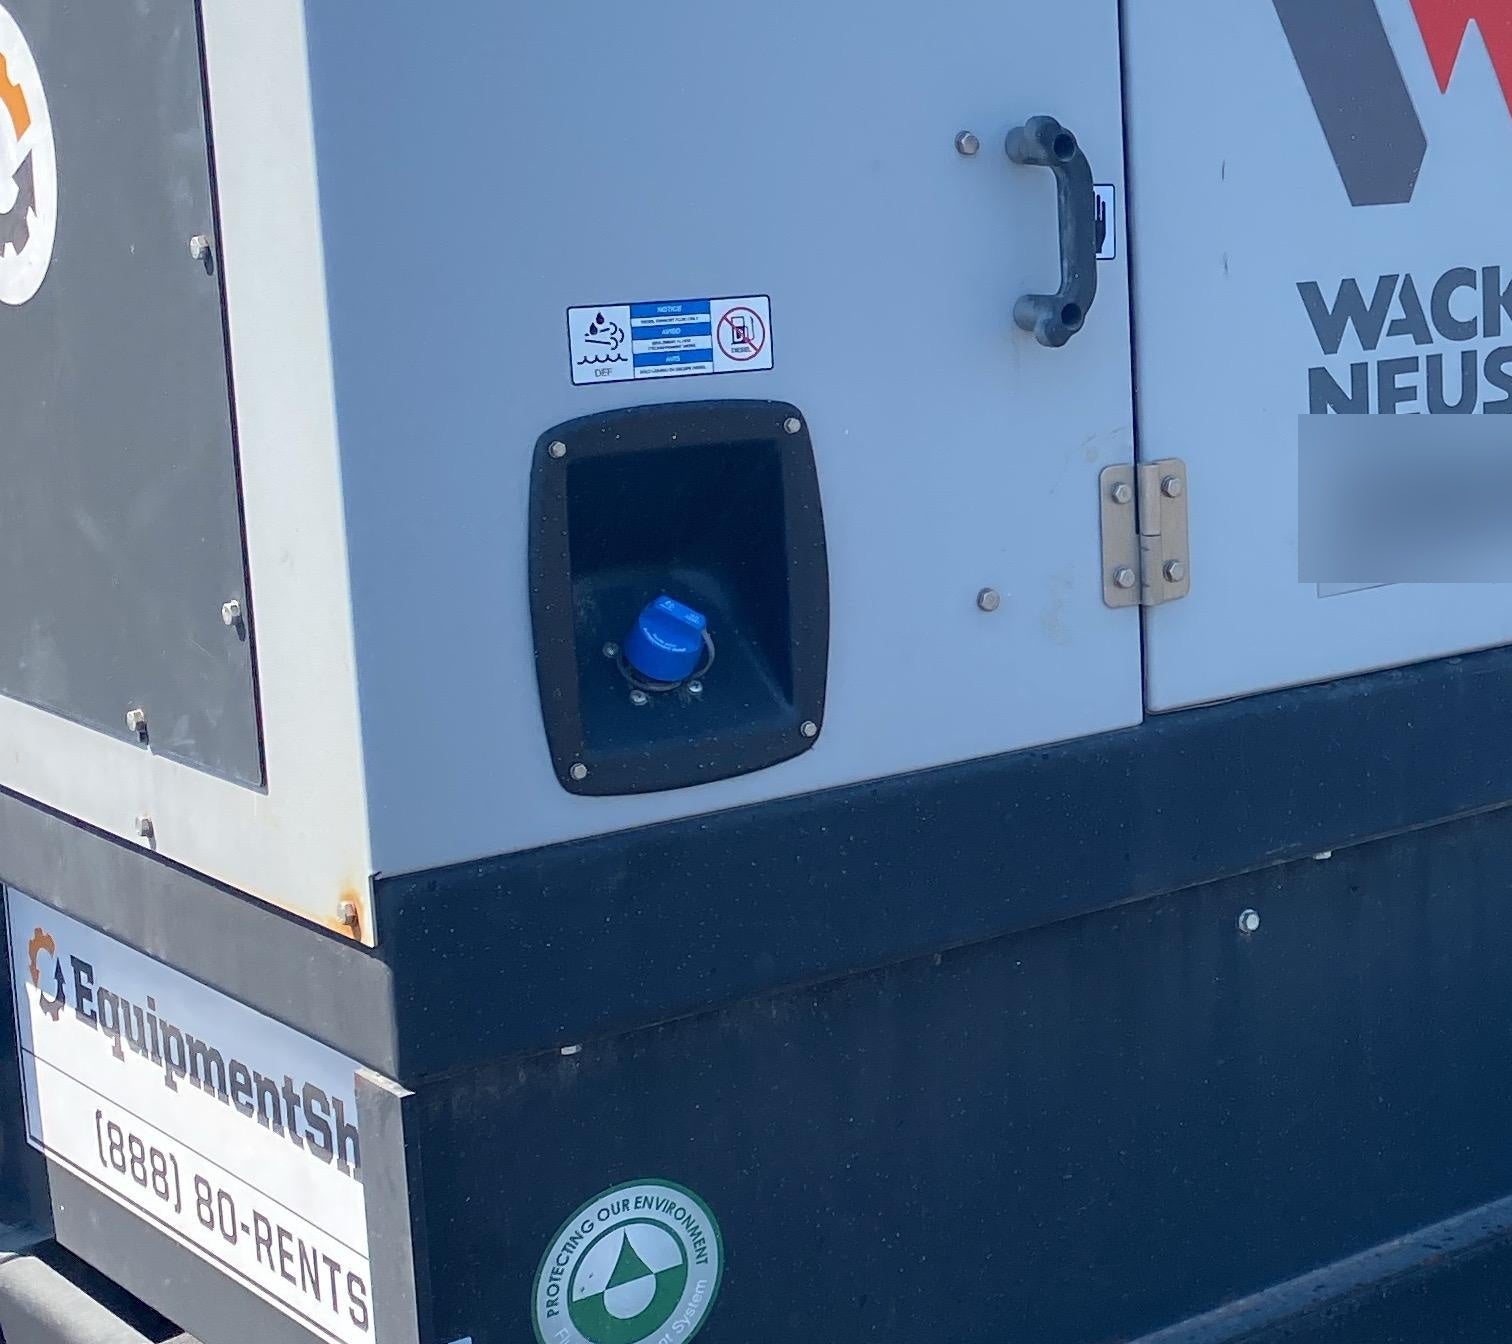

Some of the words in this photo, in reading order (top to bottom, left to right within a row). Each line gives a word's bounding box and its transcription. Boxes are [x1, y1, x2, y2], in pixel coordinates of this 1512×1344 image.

[95, 1108, 182, 1214] (888)
[194, 1173, 370, 1334] 80-RENTS
[546, 1219, 595, 1319] PROTECTING
[597, 1198, 631, 1222] OUR
[633, 1195, 709, 1266] ENVIRONMENT
[671, 1278, 708, 1335] System
